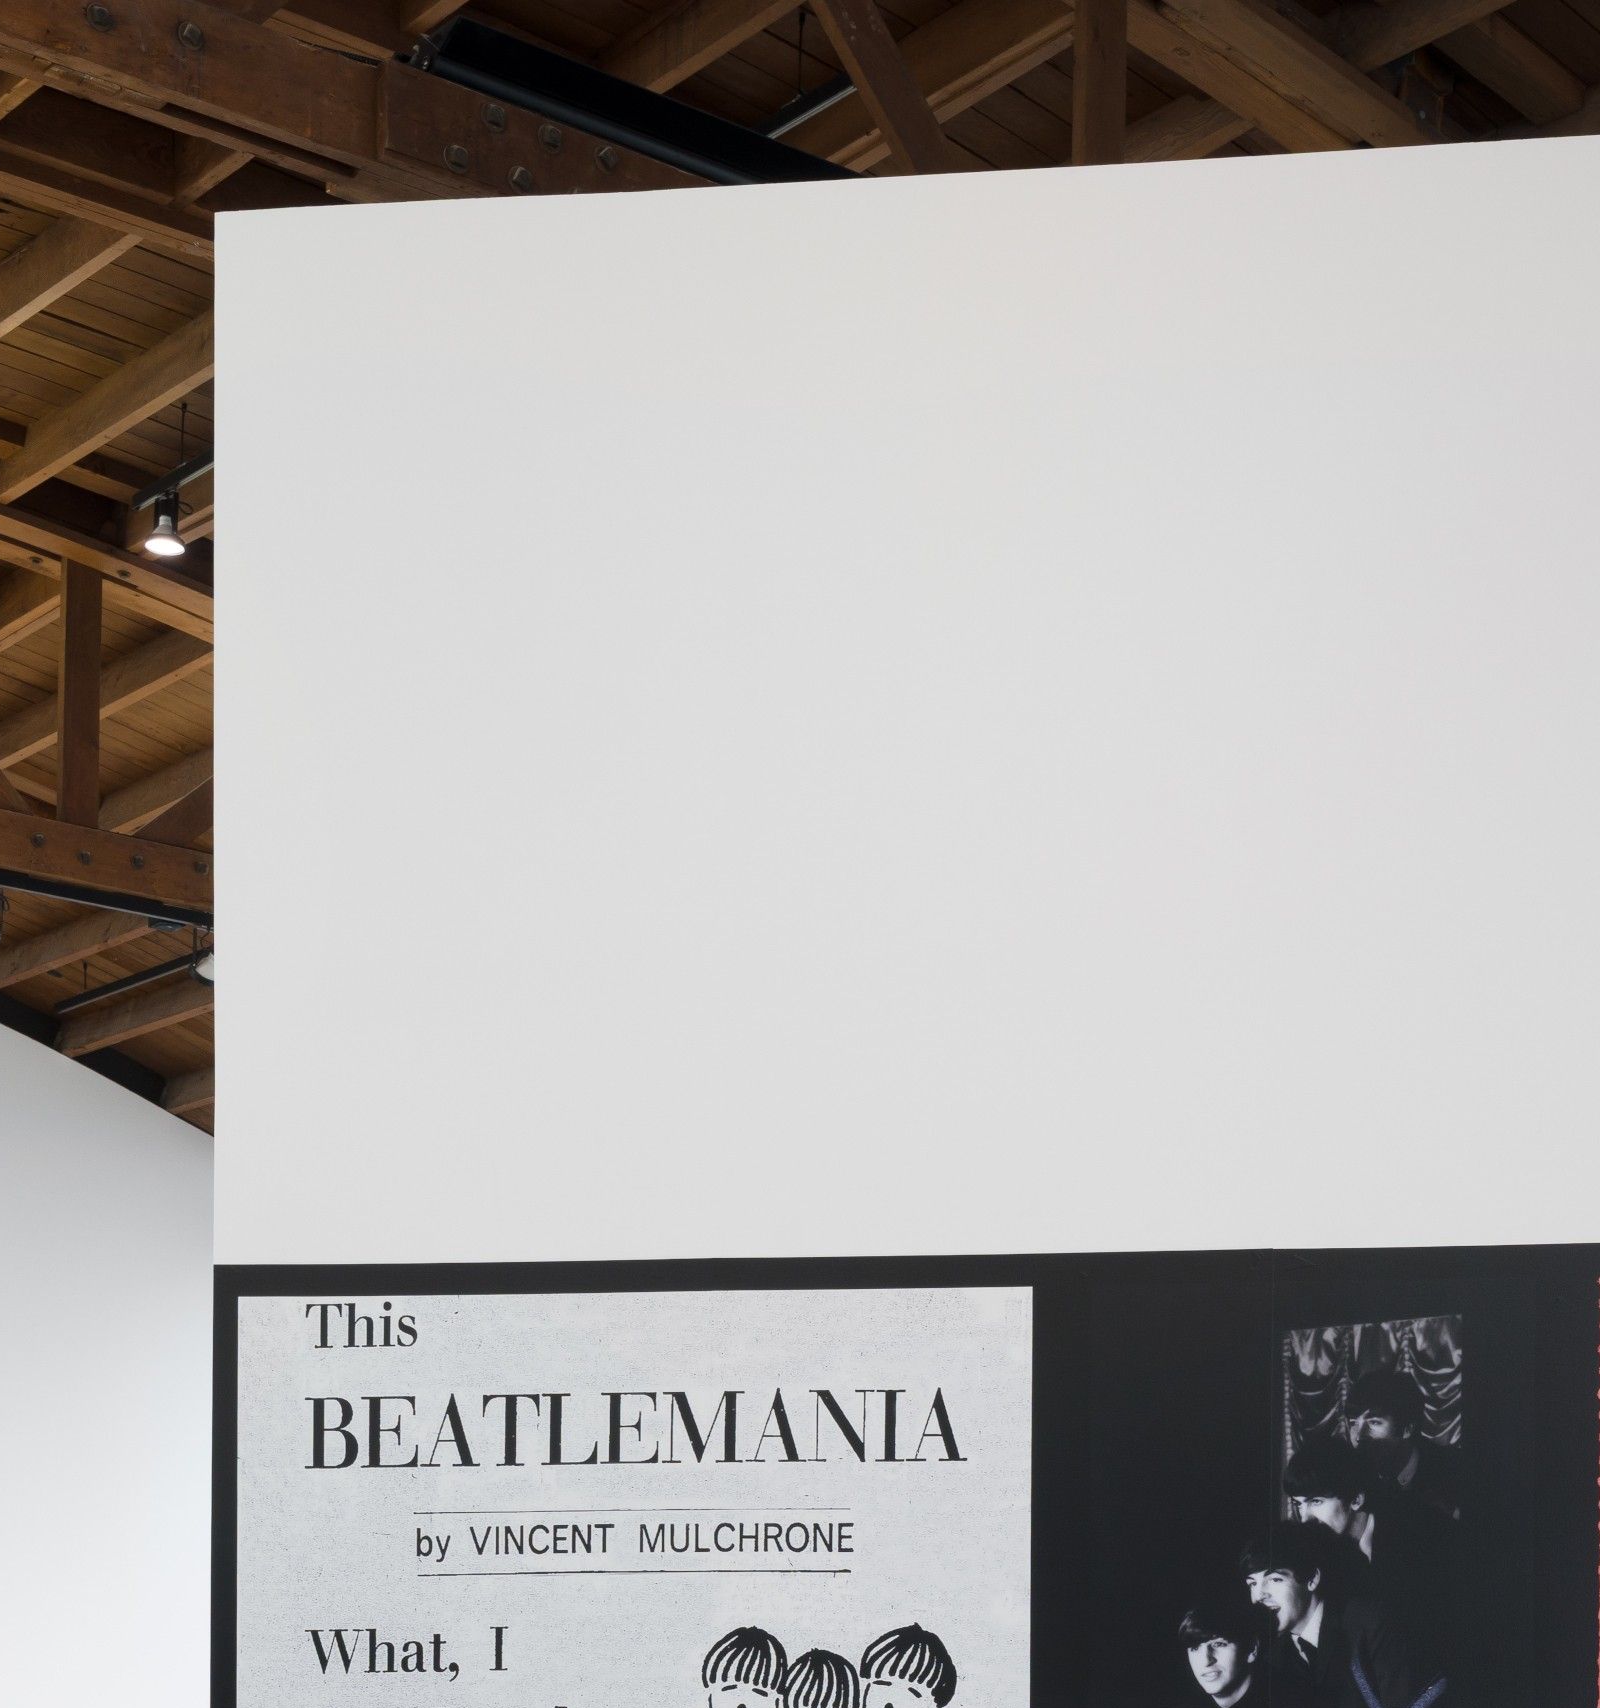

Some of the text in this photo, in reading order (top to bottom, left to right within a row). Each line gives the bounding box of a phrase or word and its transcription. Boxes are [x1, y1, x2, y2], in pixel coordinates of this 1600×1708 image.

[306, 1302, 418, 1350] This
[304, 1387, 968, 1469] BEATLEMANIA
[416, 1522, 855, 1562] by VINCENT MULCHRONE
[304, 1627, 508, 1681] What, I
